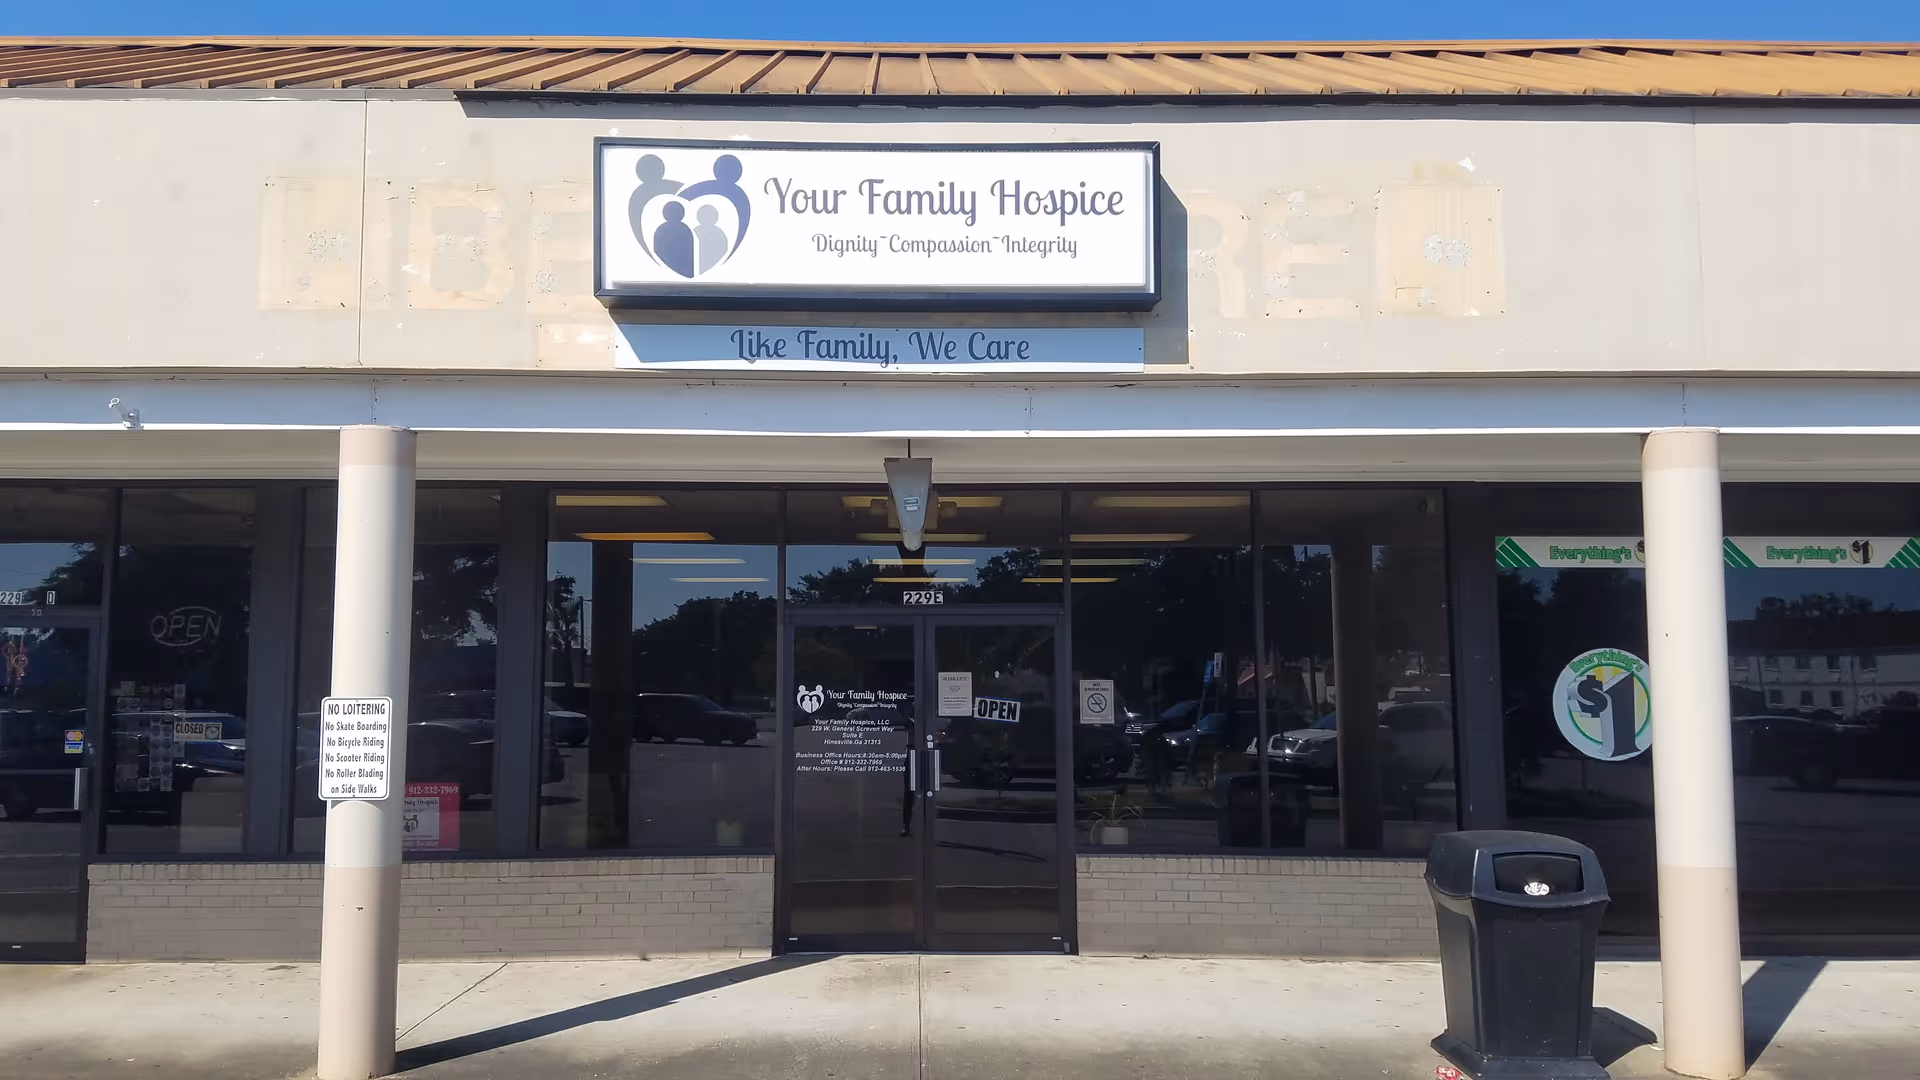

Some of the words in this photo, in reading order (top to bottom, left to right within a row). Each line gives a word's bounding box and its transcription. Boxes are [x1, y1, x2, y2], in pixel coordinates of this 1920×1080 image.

[764, 177, 847, 215] Your
[858, 178, 976, 227] Family
[990, 179, 1125, 227] Hospice
[730, 329, 787, 364] Like
[797, 329, 898, 369] Family,
[908, 330, 958, 360] We
[967, 331, 1031, 360] Care
[1549, 545, 1632, 563] Everything's
[1766, 545, 1847, 564] Everything's
[904, 592, 943, 604] 229E
[150, 615, 222, 639] OPEN
[1568, 649, 1645, 674] Everything's
[826, 689, 846, 700] Your
[847, 689, 875, 702] Family
[876, 690, 908, 702] Hospice
[327, 703, 340, 715] NO
[342, 703, 386, 715] LOITERING
[977, 699, 1018, 721] OPEN
[1568, 670, 1643, 759] $1
[175, 723, 204, 735] CLOSED
[325, 721, 335, 731] No
[336, 721, 355, 731] Skate
[356, 721, 387, 734] Boarding
[326, 737, 336, 747] No
[338, 737, 361, 750] Bicycle
[362, 737, 385, 749] Riding
[325, 753, 334, 762] No
[336, 752, 362, 762] Scooter
[363, 753, 385, 765] Riding
[325, 768, 335, 778] No
[336, 768, 357, 778] Roller
[358, 768, 384, 780] Blading
[330, 786, 339, 794] on
[341, 783, 356, 794] Side
[358, 783, 377, 794] Walks
[408, 785, 459, 795] 912-332-7969
